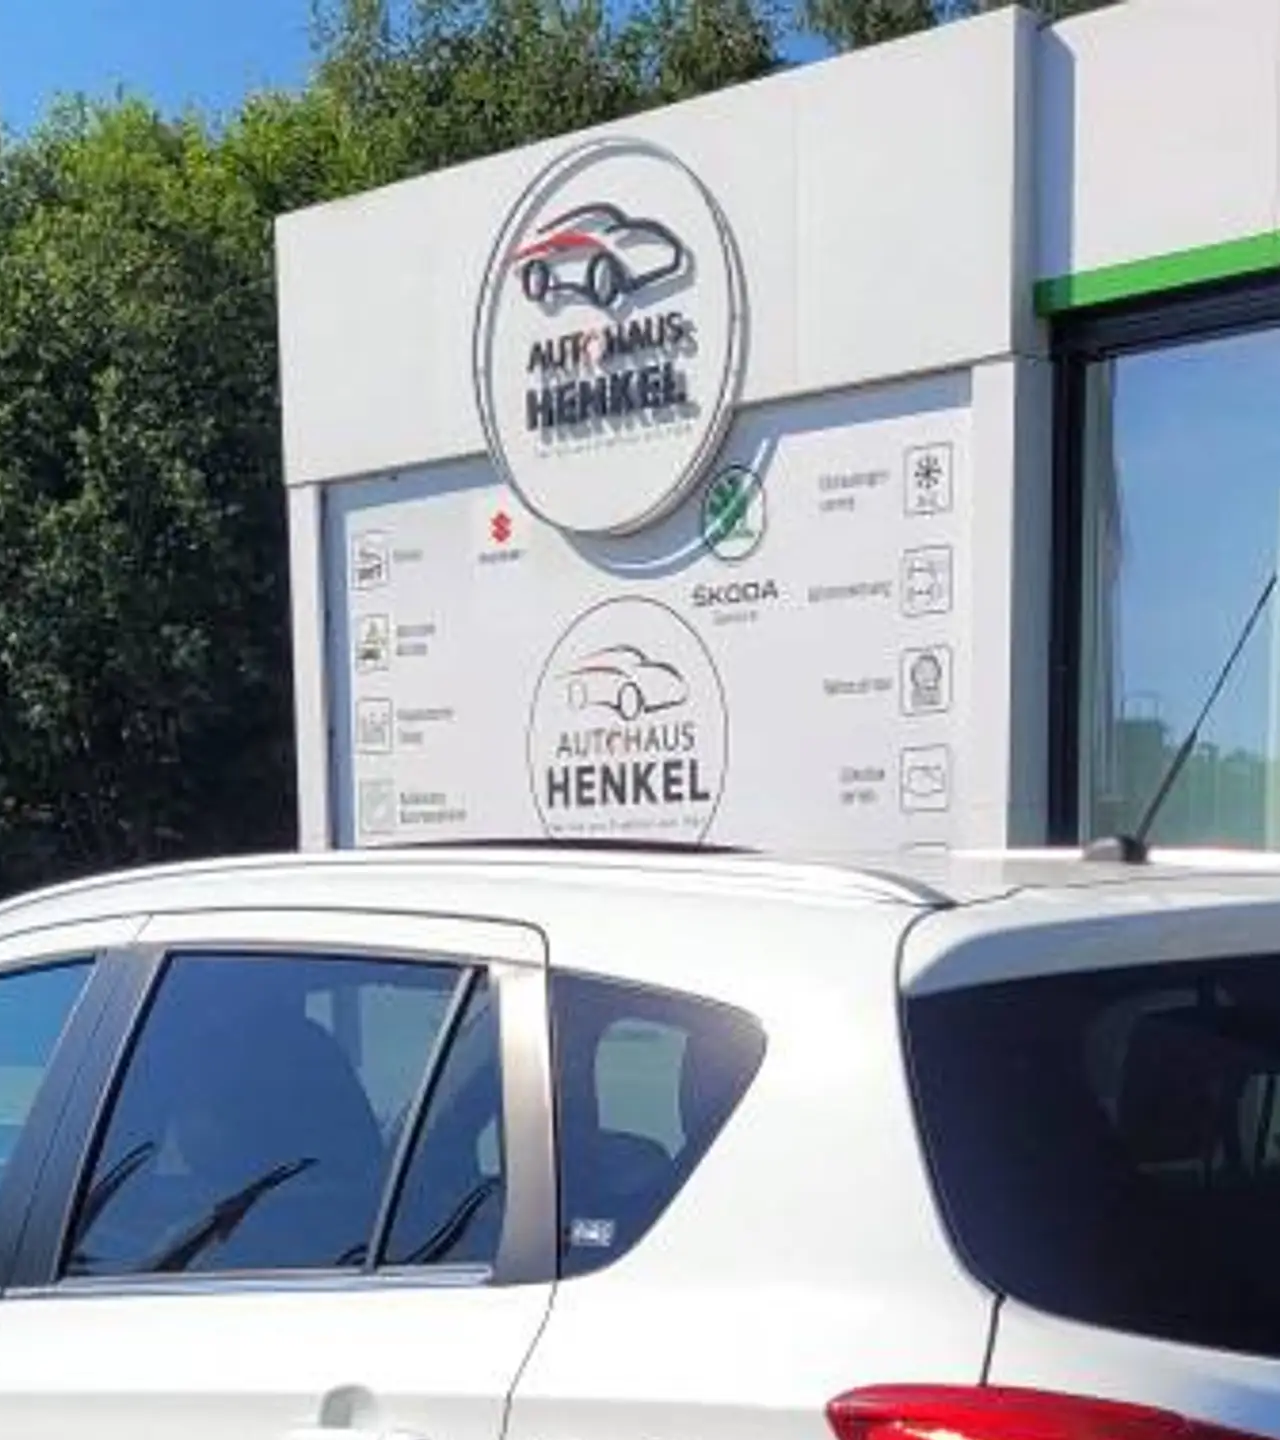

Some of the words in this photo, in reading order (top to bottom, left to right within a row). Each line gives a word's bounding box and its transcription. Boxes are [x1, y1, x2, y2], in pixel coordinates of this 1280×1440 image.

[526, 312, 684, 373] AUTOHAUS
[526, 361, 687, 431] HENKEL
[556, 721, 696, 758] AUTOHAUS
[548, 759, 710, 809] HENKEL
